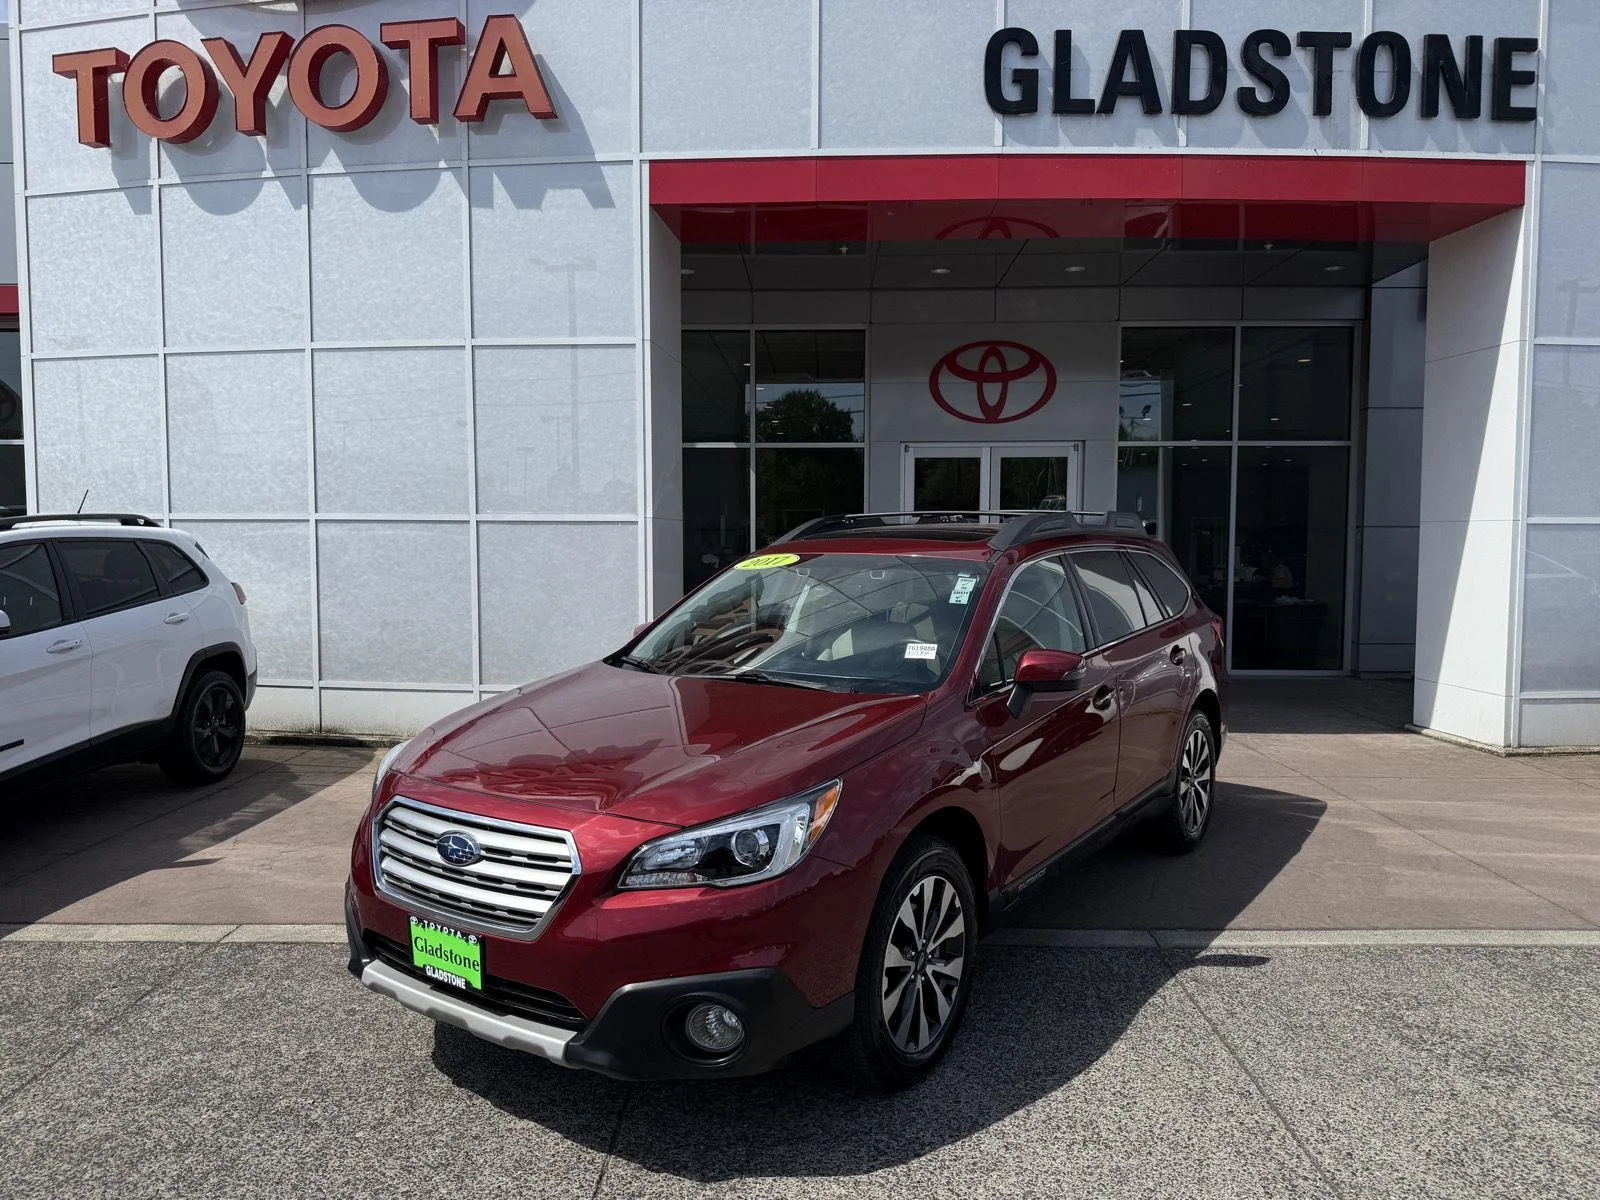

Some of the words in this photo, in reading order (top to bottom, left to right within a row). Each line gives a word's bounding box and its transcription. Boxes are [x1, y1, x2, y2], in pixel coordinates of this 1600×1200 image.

[52, 14, 558, 148] TOYOTA
[984, 27, 1538, 121] GLADSTONE
[423, 920, 463, 939] TOYOTA
[413, 936, 480, 972] Gladstone
[425, 965, 466, 989] GLADSTONE
